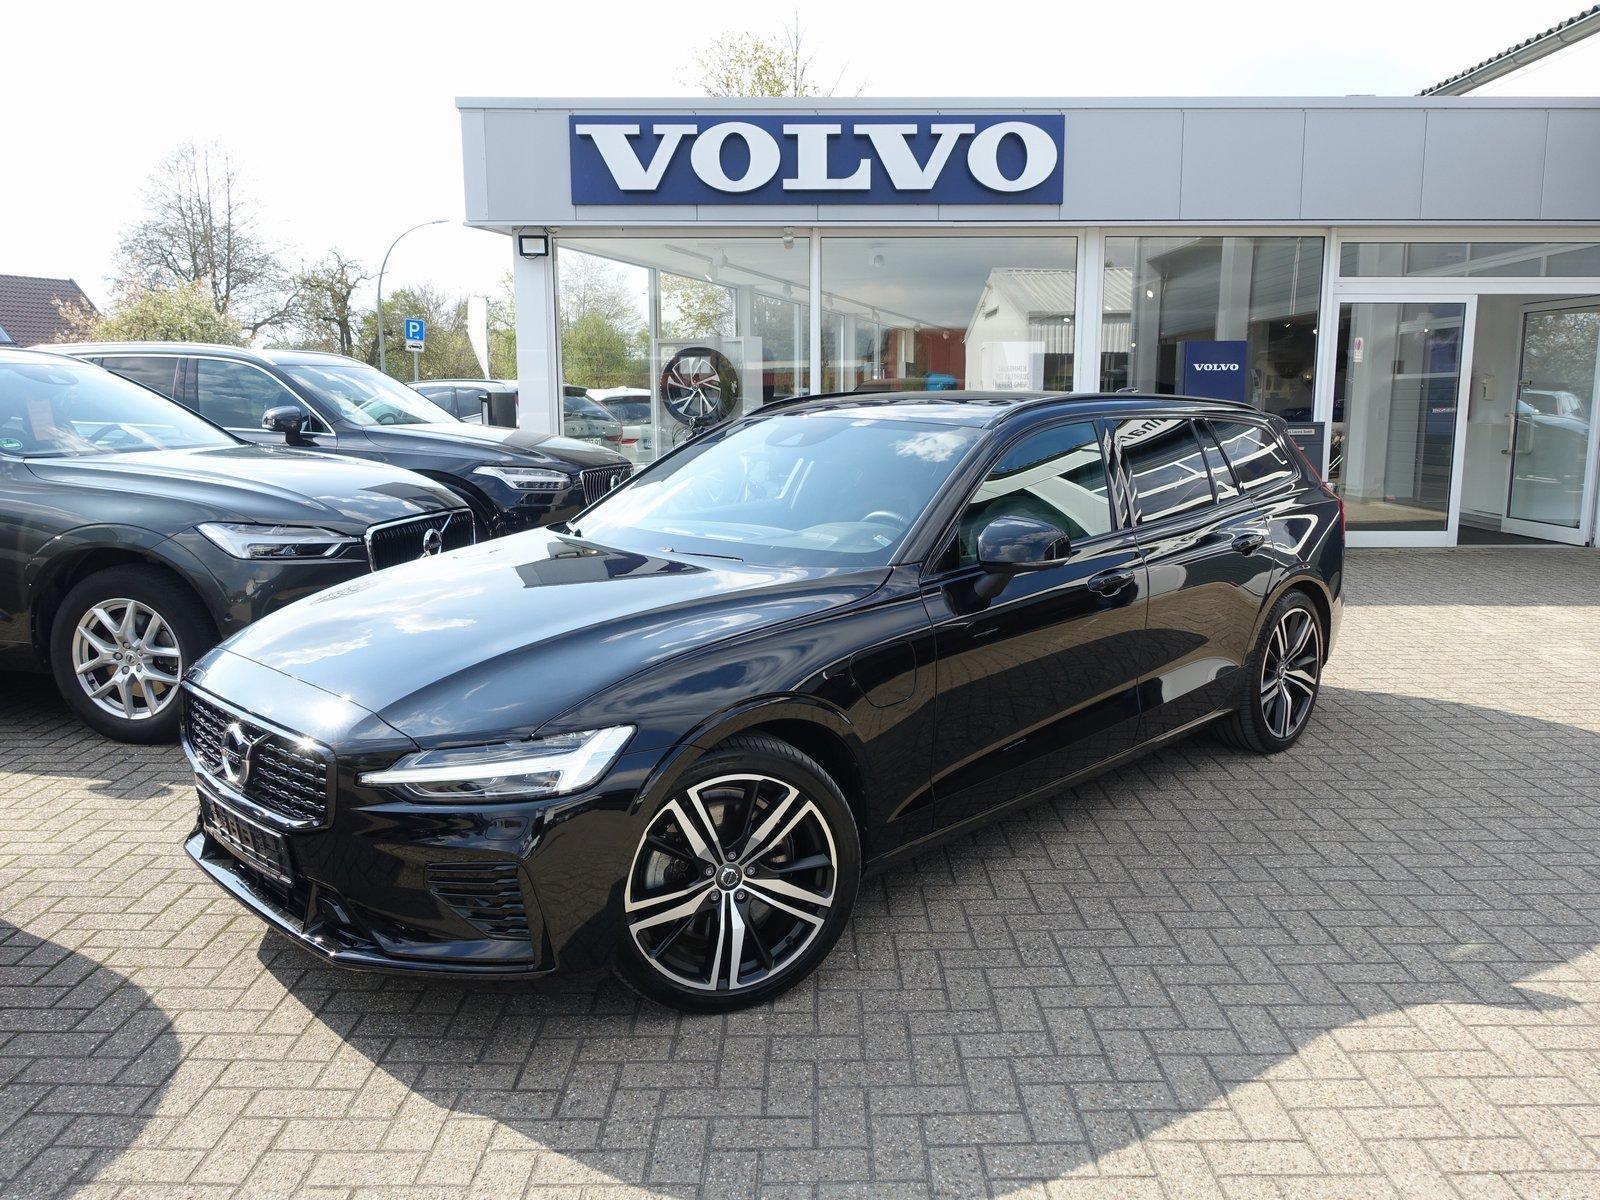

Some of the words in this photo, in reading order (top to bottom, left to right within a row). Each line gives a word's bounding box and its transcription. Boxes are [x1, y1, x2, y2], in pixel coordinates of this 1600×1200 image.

[576, 121, 1057, 192] VOLVO
[409, 321, 420, 338] P
[1193, 363, 1239, 371] VOLVO
